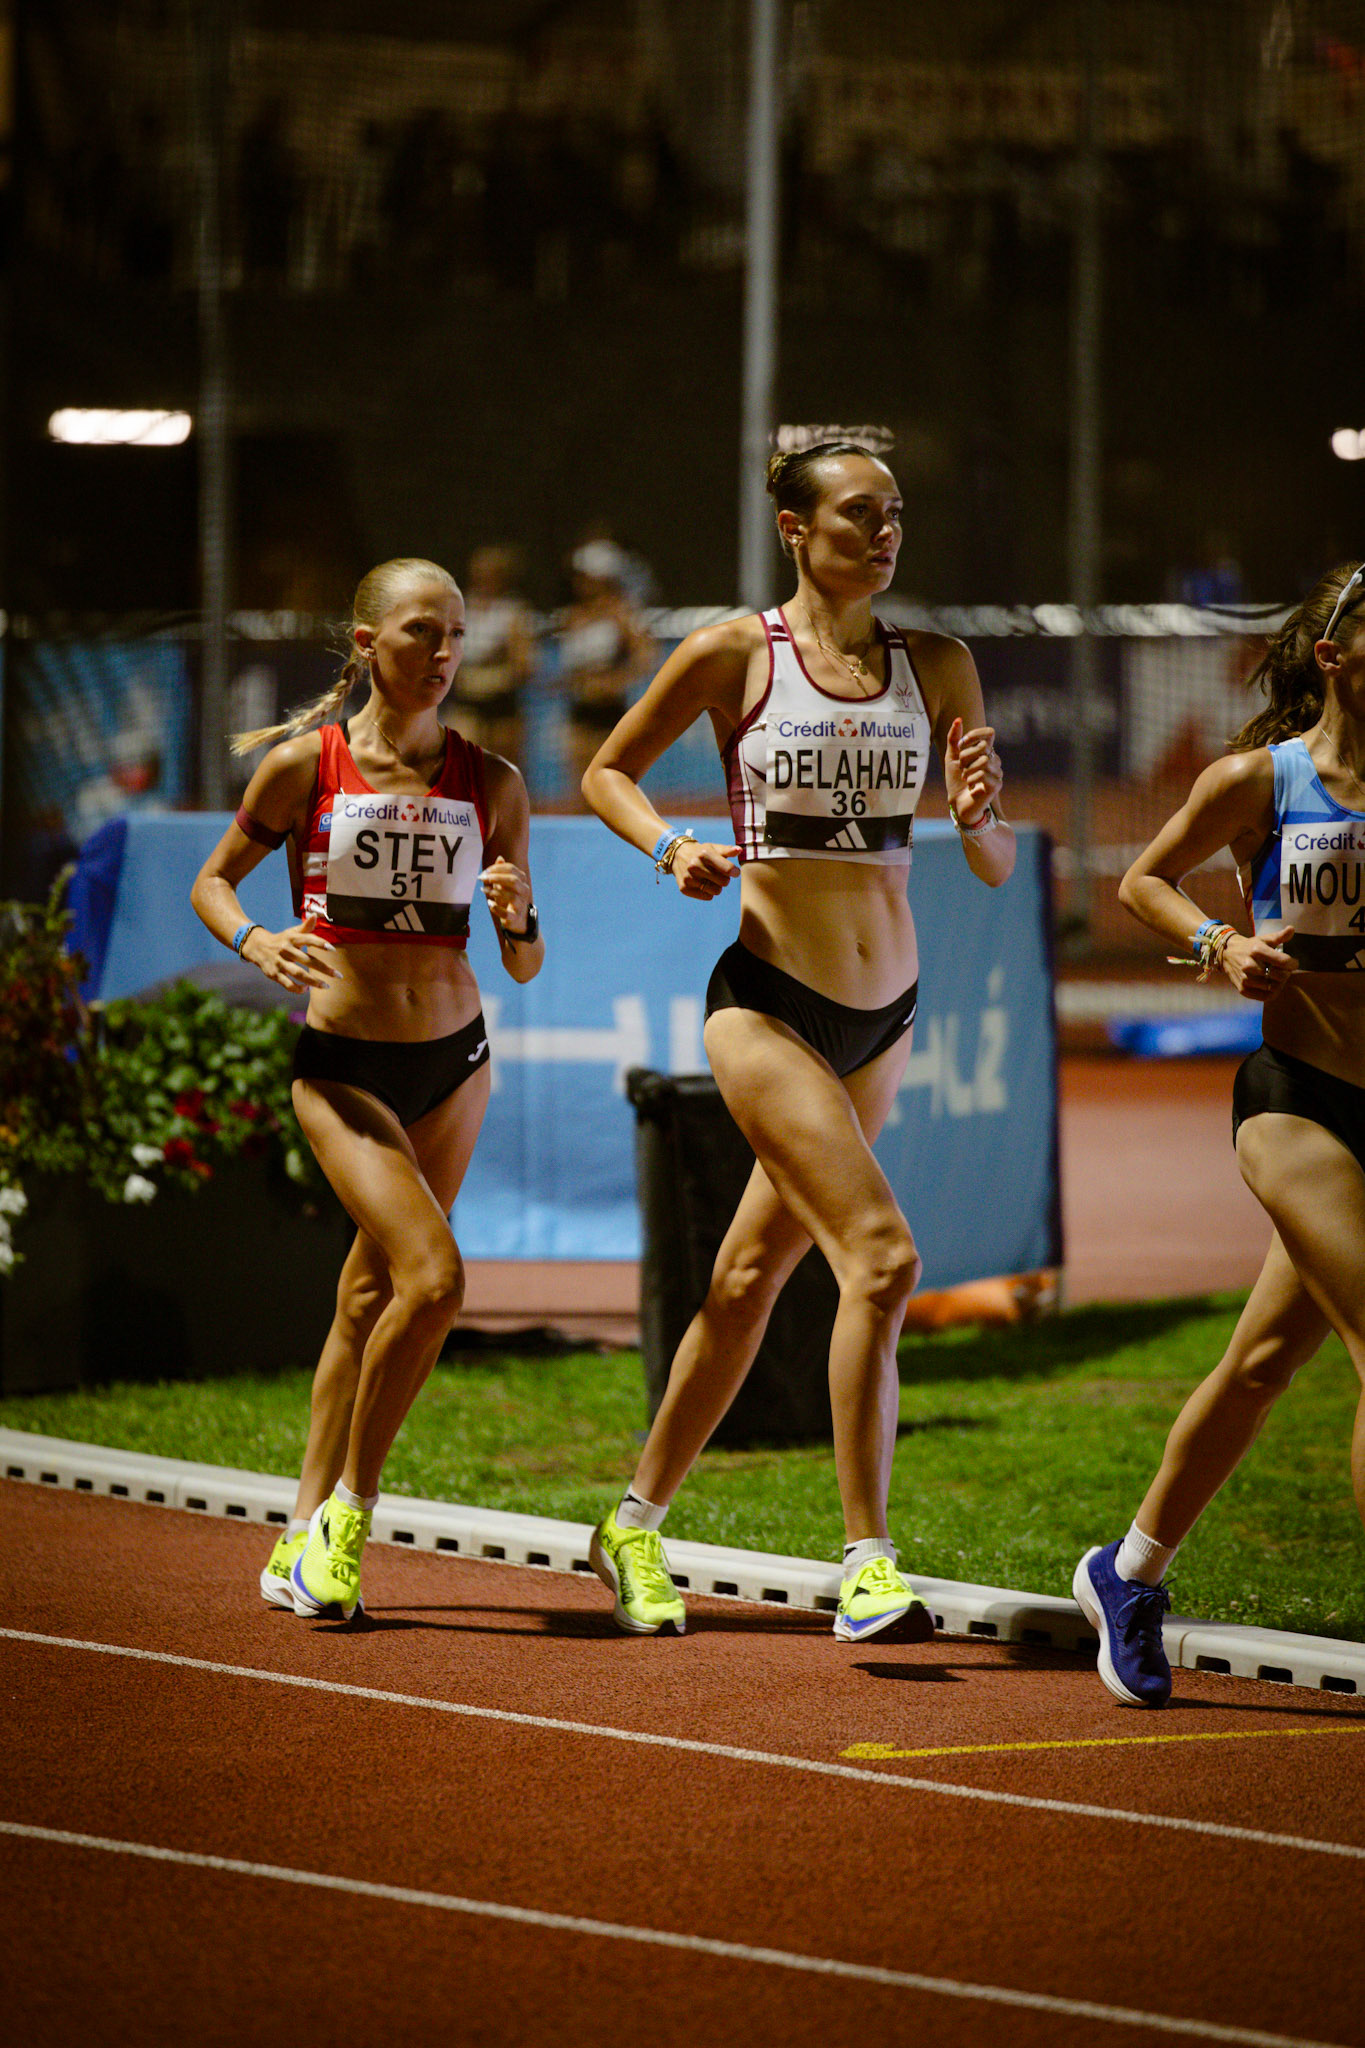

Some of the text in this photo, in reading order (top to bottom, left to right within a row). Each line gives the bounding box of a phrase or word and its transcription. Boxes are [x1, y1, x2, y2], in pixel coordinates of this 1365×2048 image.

[779, 721, 915, 739] Crédit Mutuel
[774, 750, 918, 789] DELAHAIE
[344, 803, 471, 827] Crédit Mutuel
[831, 790, 867, 817] 36
[353, 829, 463, 874] STEY
[1294, 833, 1356, 851] Crédit
[390, 873, 423, 898] 51
[1289, 862, 1365, 906] MOU
